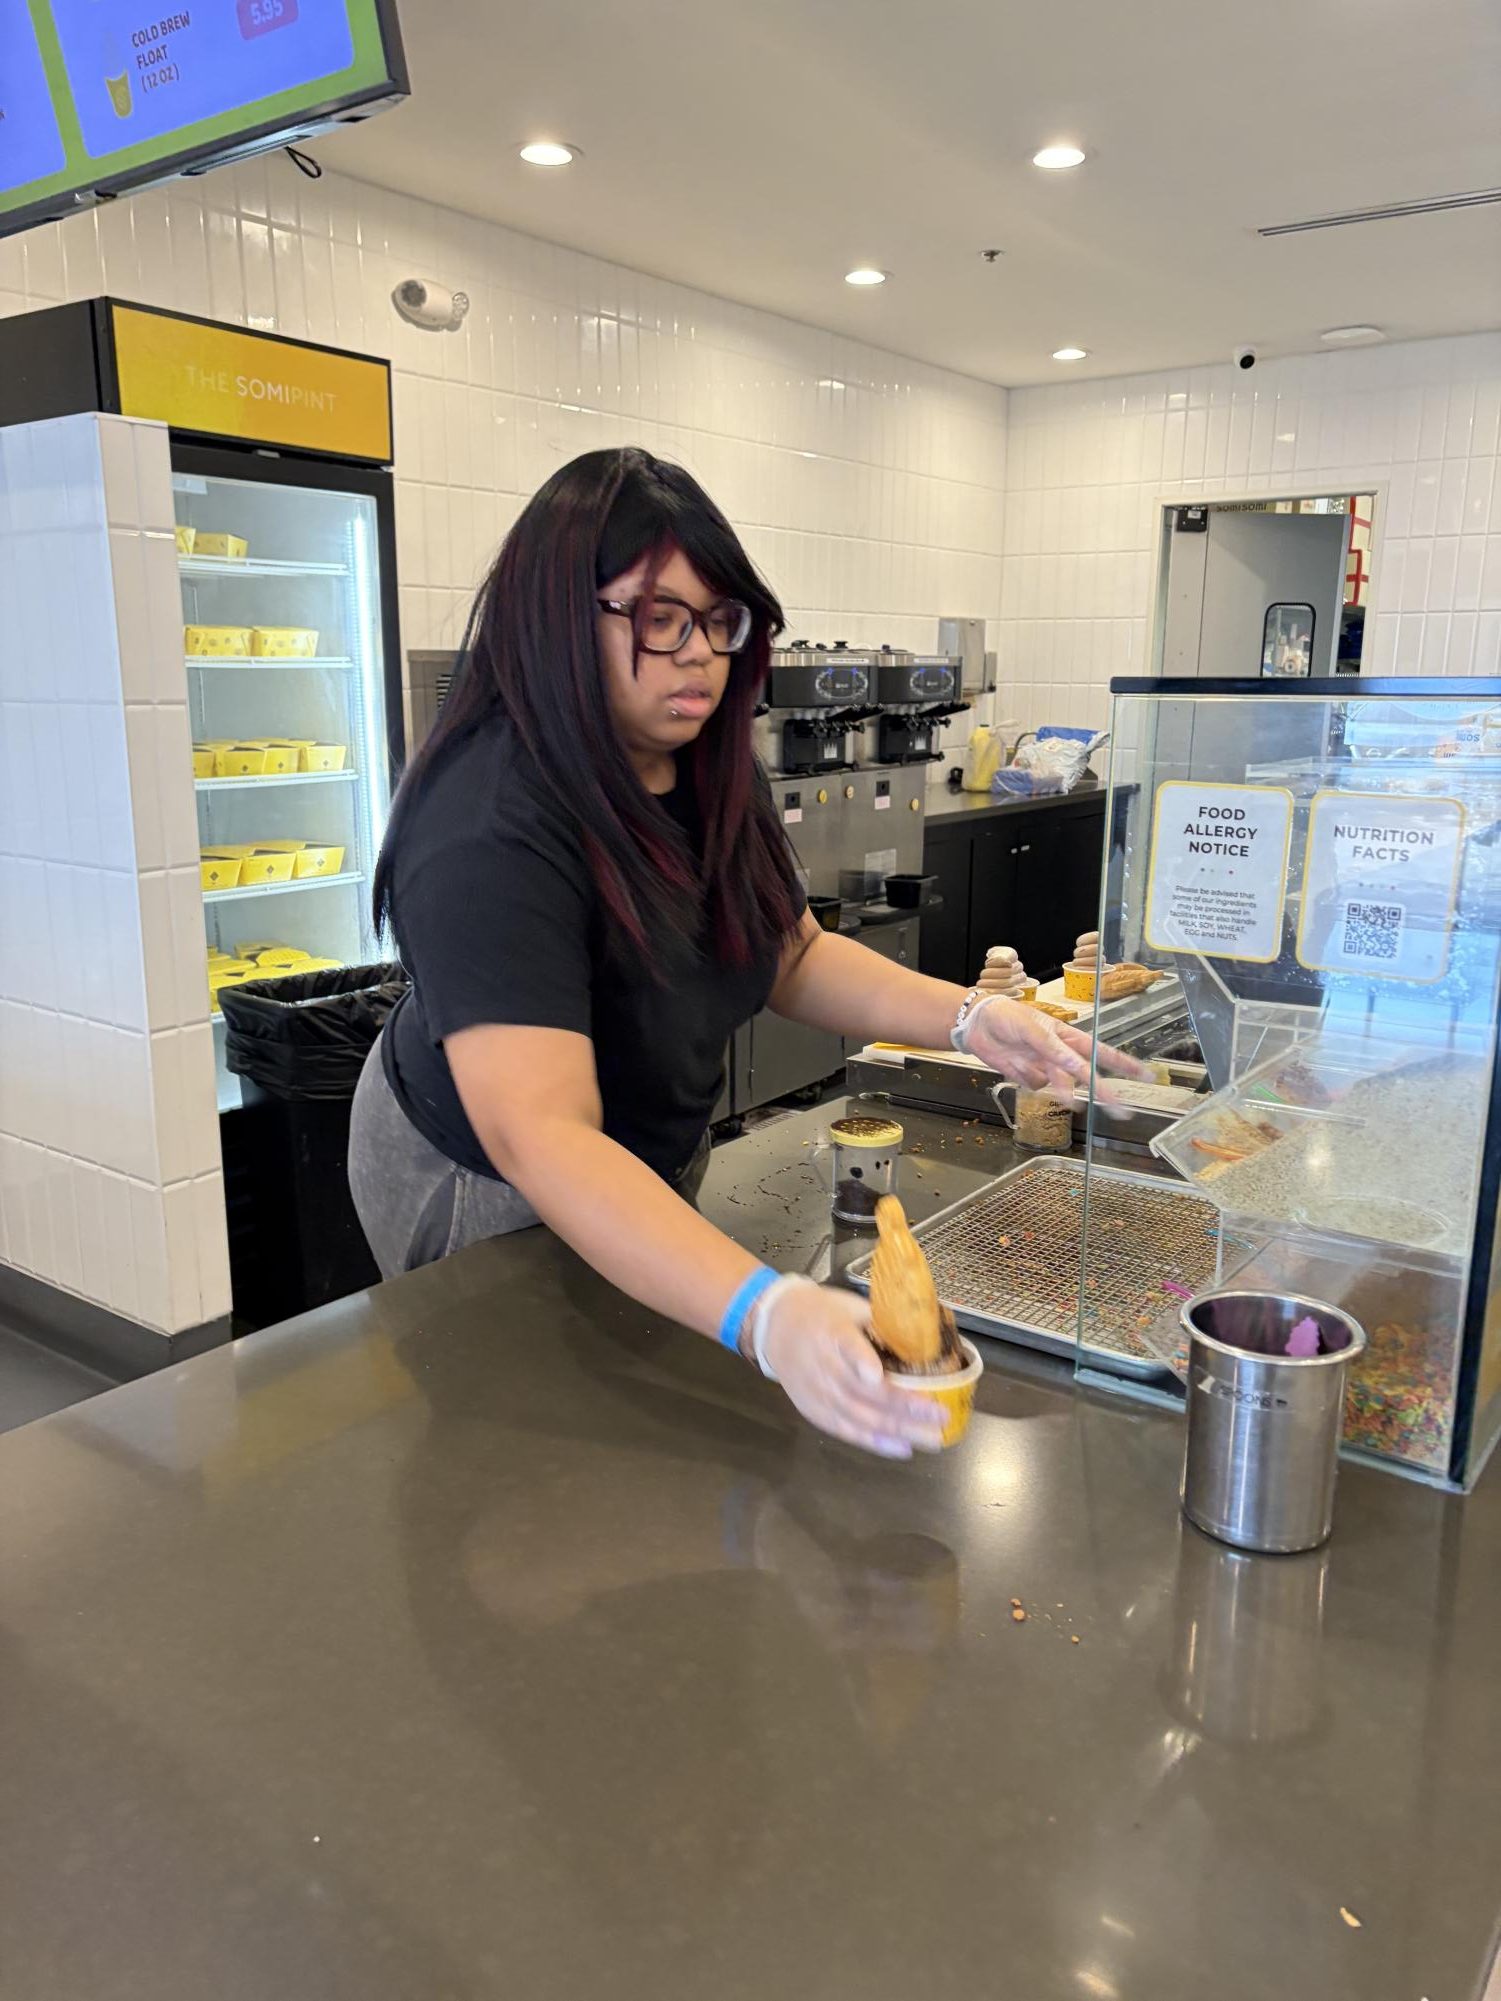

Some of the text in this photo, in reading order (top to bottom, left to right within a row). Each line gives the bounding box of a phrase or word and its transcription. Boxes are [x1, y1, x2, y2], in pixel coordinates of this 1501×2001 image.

[250, 0, 284, 25] 5.95
[131, 10, 190, 48] COLD BREW
[136, 44, 168, 70] FLOAT
[141, 62, 179, 93] (12 OZ)
[184, 365, 338, 413] THE SOMIPINT
[1199, 806, 1246, 821] FOOD
[1183, 823, 1258, 840] ALLERGY
[1334, 825, 1434, 845] NUTRITION
[1189, 841, 1249, 857] NOTICE
[1352, 846, 1411, 862] FACTS
[1176, 885, 1198, 894] Please
[1200, 887, 1209, 895] be
[1210, 889, 1239, 898] advised
[1177, 903, 1192, 911] may
[1204, 906, 1241, 915] processed
[1215, 898, 1257, 908] ingredients
[1169, 910, 1198, 919] facilities
[1231, 917, 1256, 925] handle
